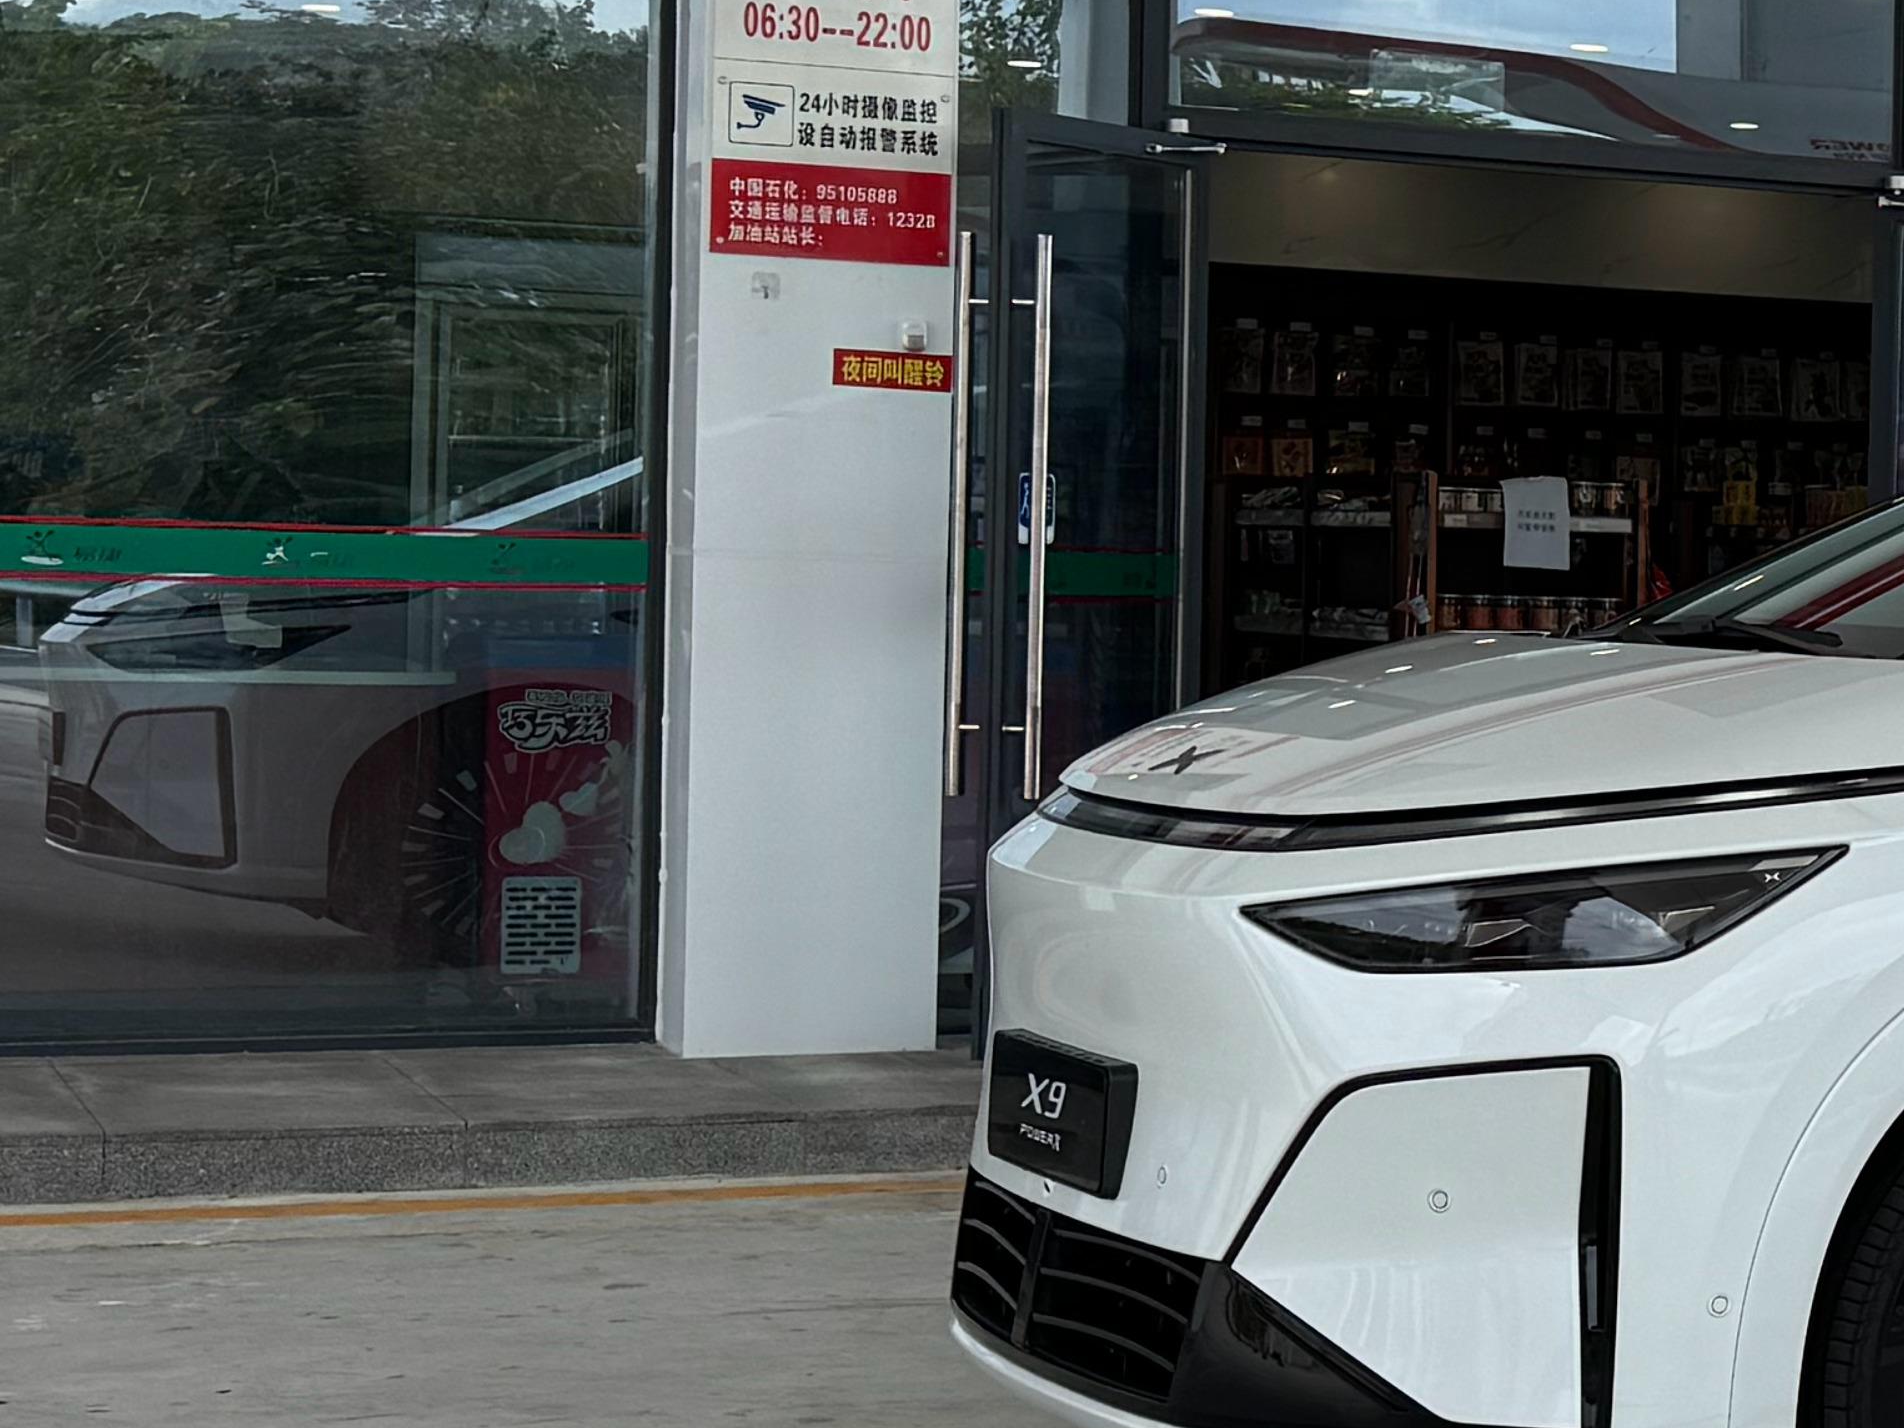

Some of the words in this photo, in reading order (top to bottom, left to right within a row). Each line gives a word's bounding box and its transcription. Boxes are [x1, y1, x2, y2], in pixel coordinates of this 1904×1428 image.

[799, 91, 938, 125] 24小时摄像监控
[797, 121, 939, 157] 设自动报警系统
[842, 354, 945, 387] 夜间叫醒铃
[1020, 1072, 1067, 1119] X9
